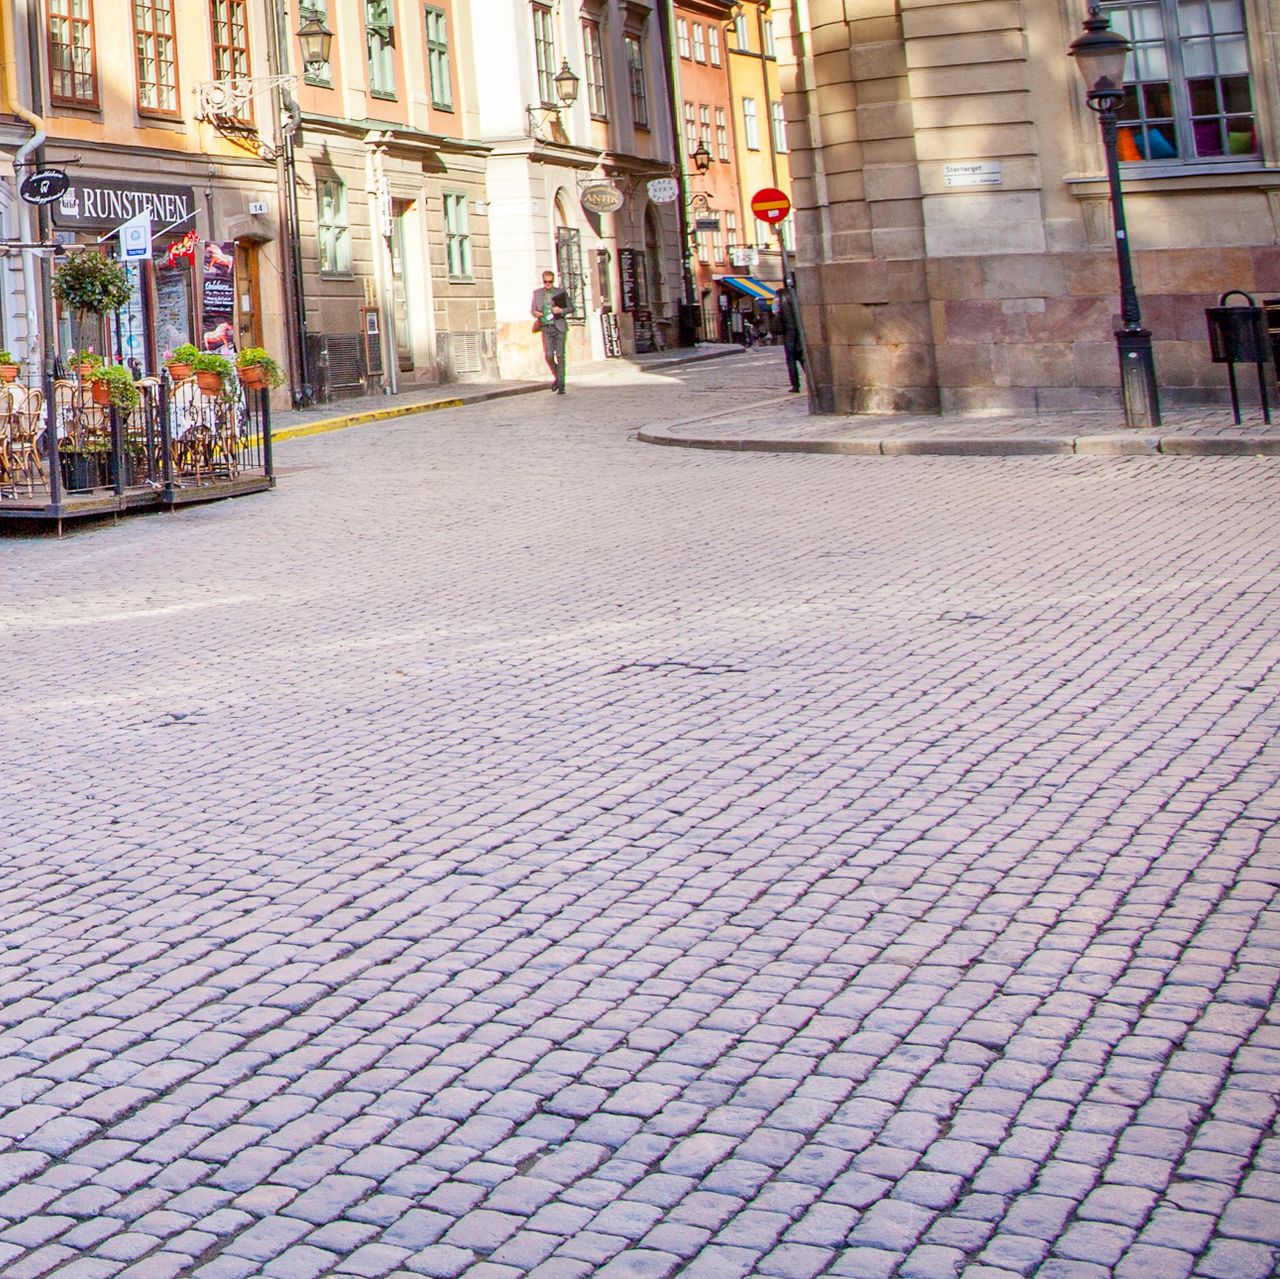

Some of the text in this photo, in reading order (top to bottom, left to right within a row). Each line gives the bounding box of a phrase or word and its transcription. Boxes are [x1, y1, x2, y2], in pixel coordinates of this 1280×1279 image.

[945, 165, 982, 174] Stortorget
[584, 191, 618, 204] ANTIK
[82, 187, 188, 222] RUNSTENEN
[253, 204, 263, 213] 14
